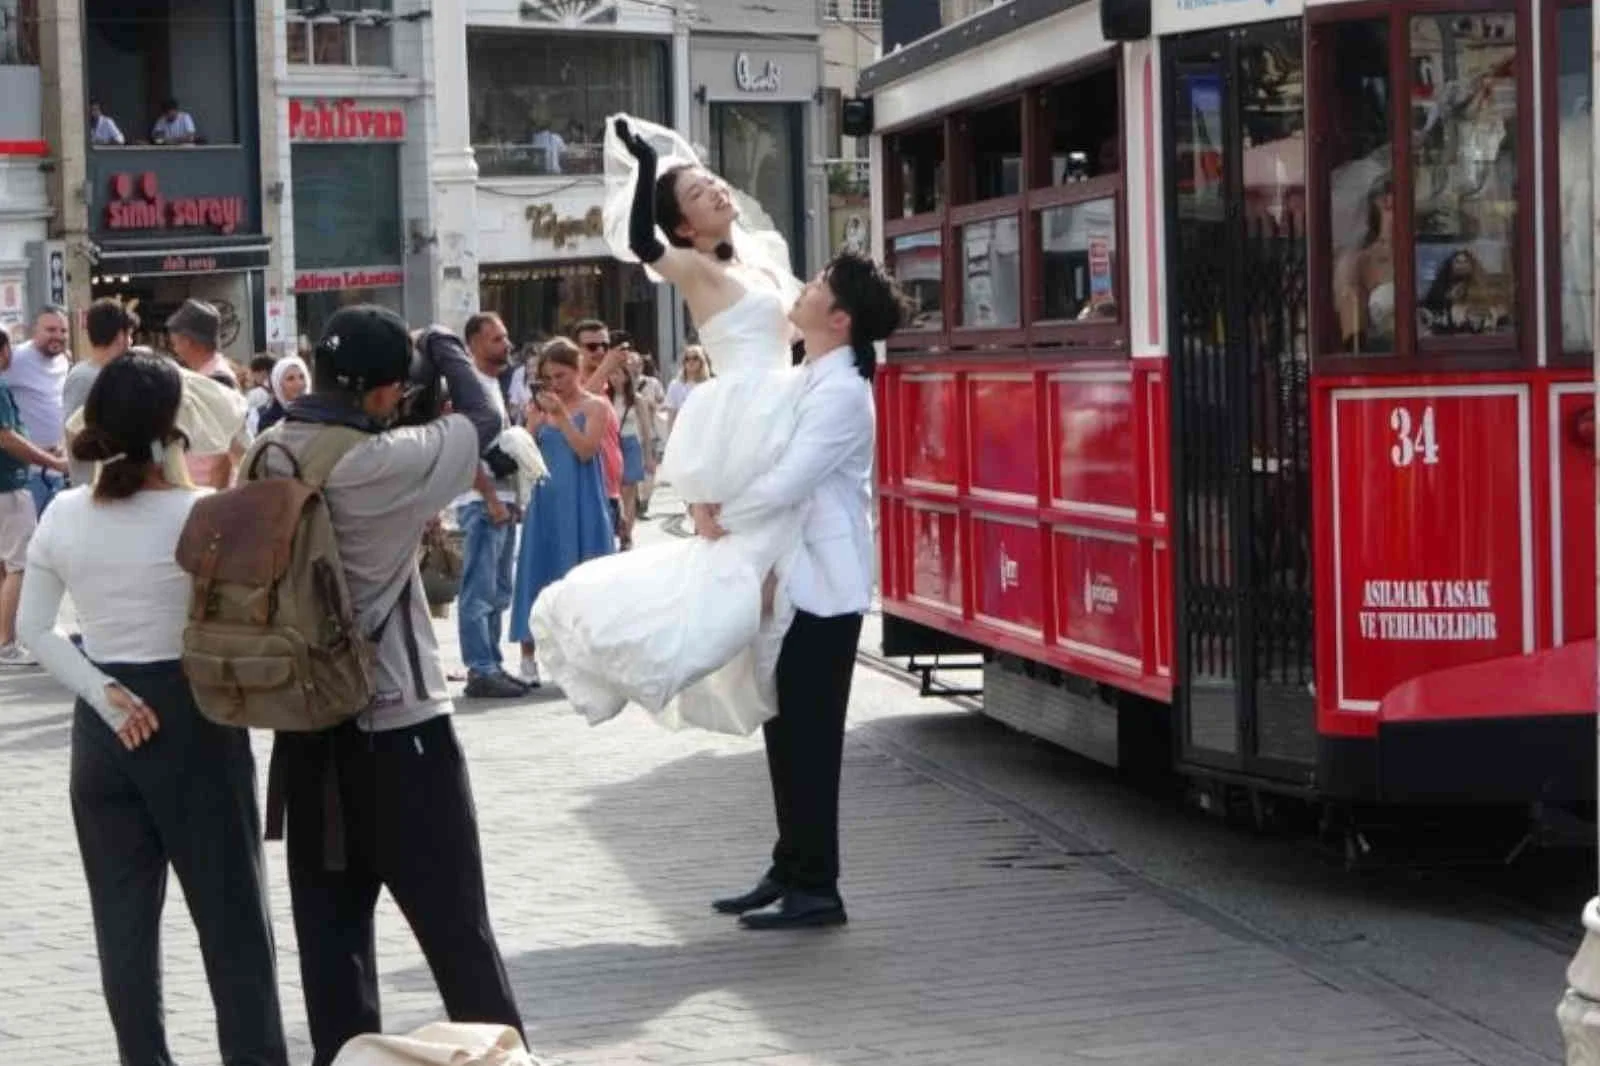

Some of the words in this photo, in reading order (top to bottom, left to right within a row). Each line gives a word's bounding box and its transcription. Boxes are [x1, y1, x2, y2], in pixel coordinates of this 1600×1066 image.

[289, 97, 405, 138] Pehlivan
[1391, 406, 1439, 466] 34
[1363, 580, 1429, 608] ASILMAK
[1431, 580, 1491, 608] YASAK
[1360, 611, 1377, 640] VE
